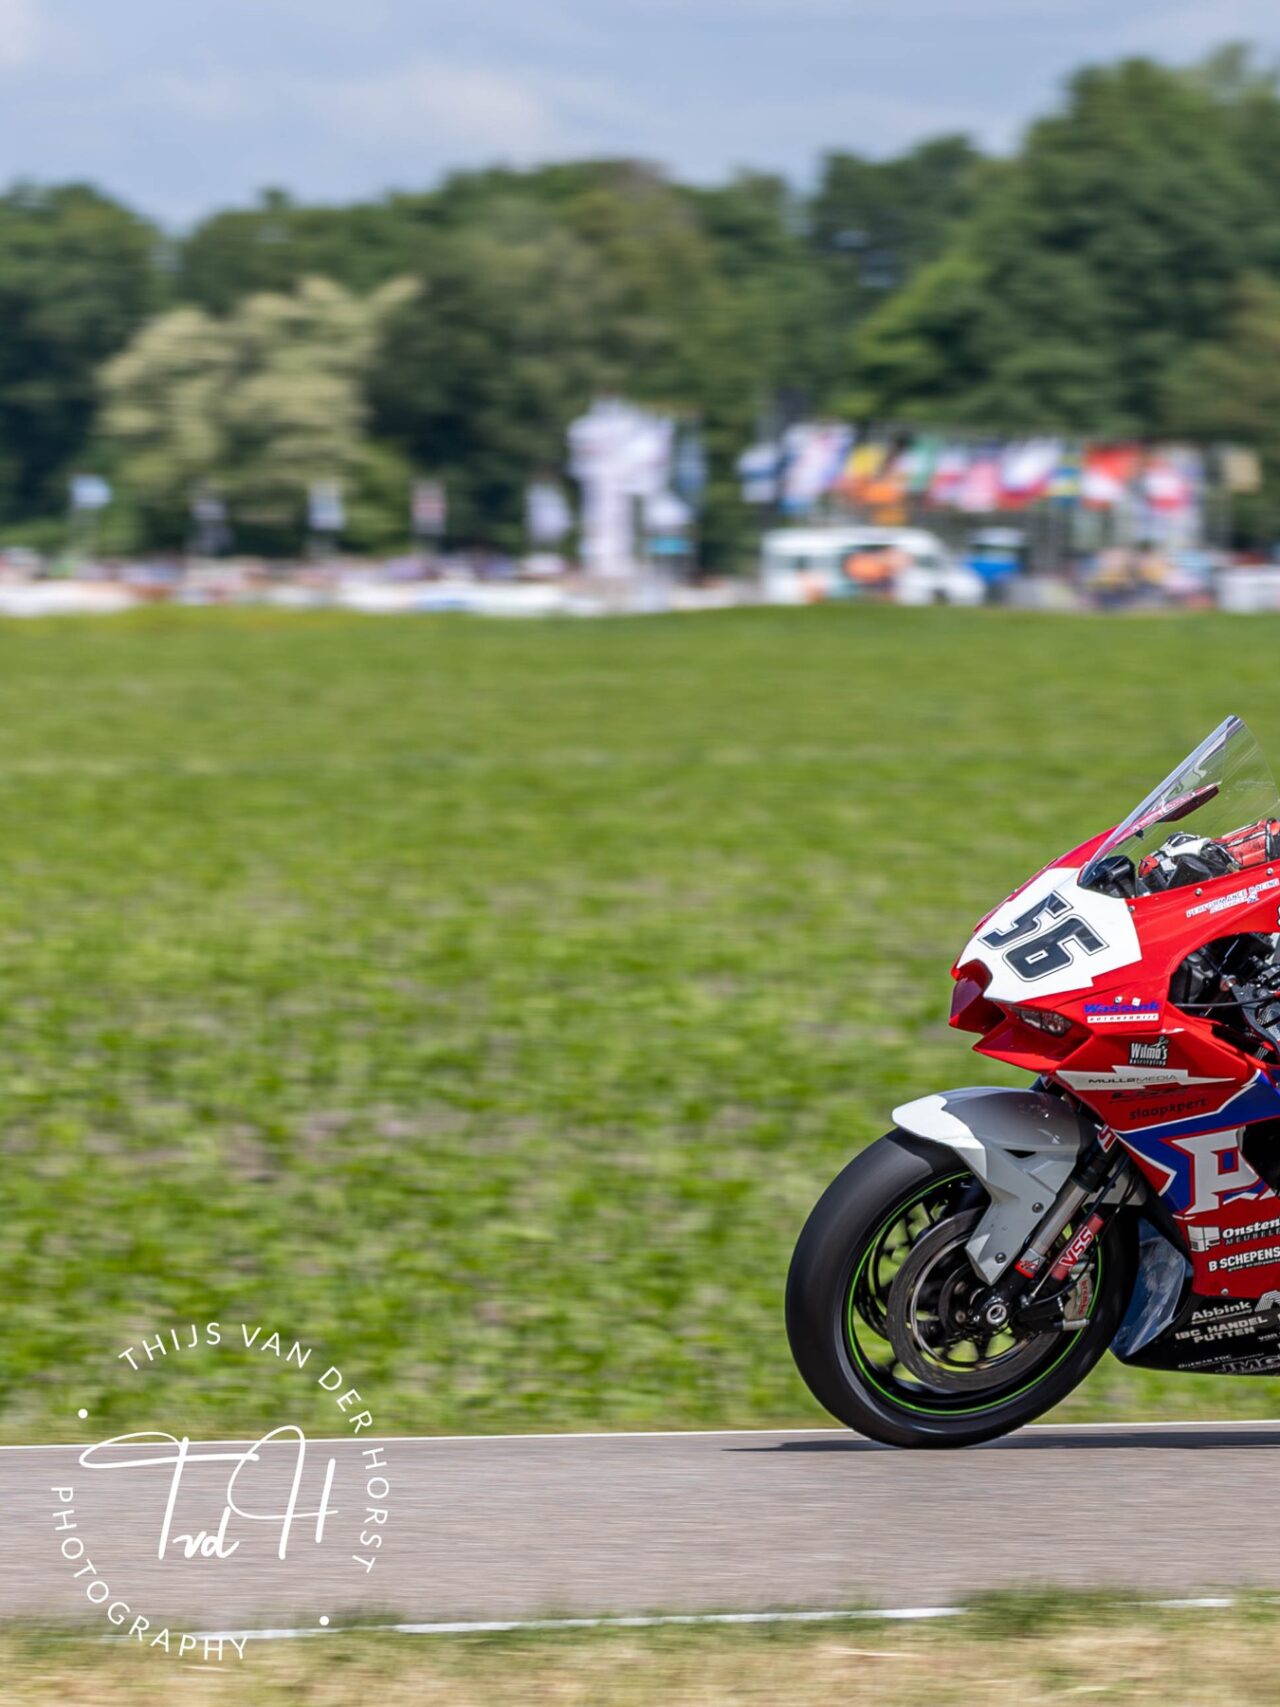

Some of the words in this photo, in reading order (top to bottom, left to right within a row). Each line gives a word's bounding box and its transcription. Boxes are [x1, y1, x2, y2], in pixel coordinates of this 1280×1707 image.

[978, 889, 1109, 982] 56
[1084, 1001, 1159, 1014] Wassink
[1208, 1261, 1218, 1272] B
[1191, 1301, 1251, 1321] Abbink
[1207, 1315, 1268, 1334] HANDEL
[1193, 1326, 1256, 1344] PUTTEN
